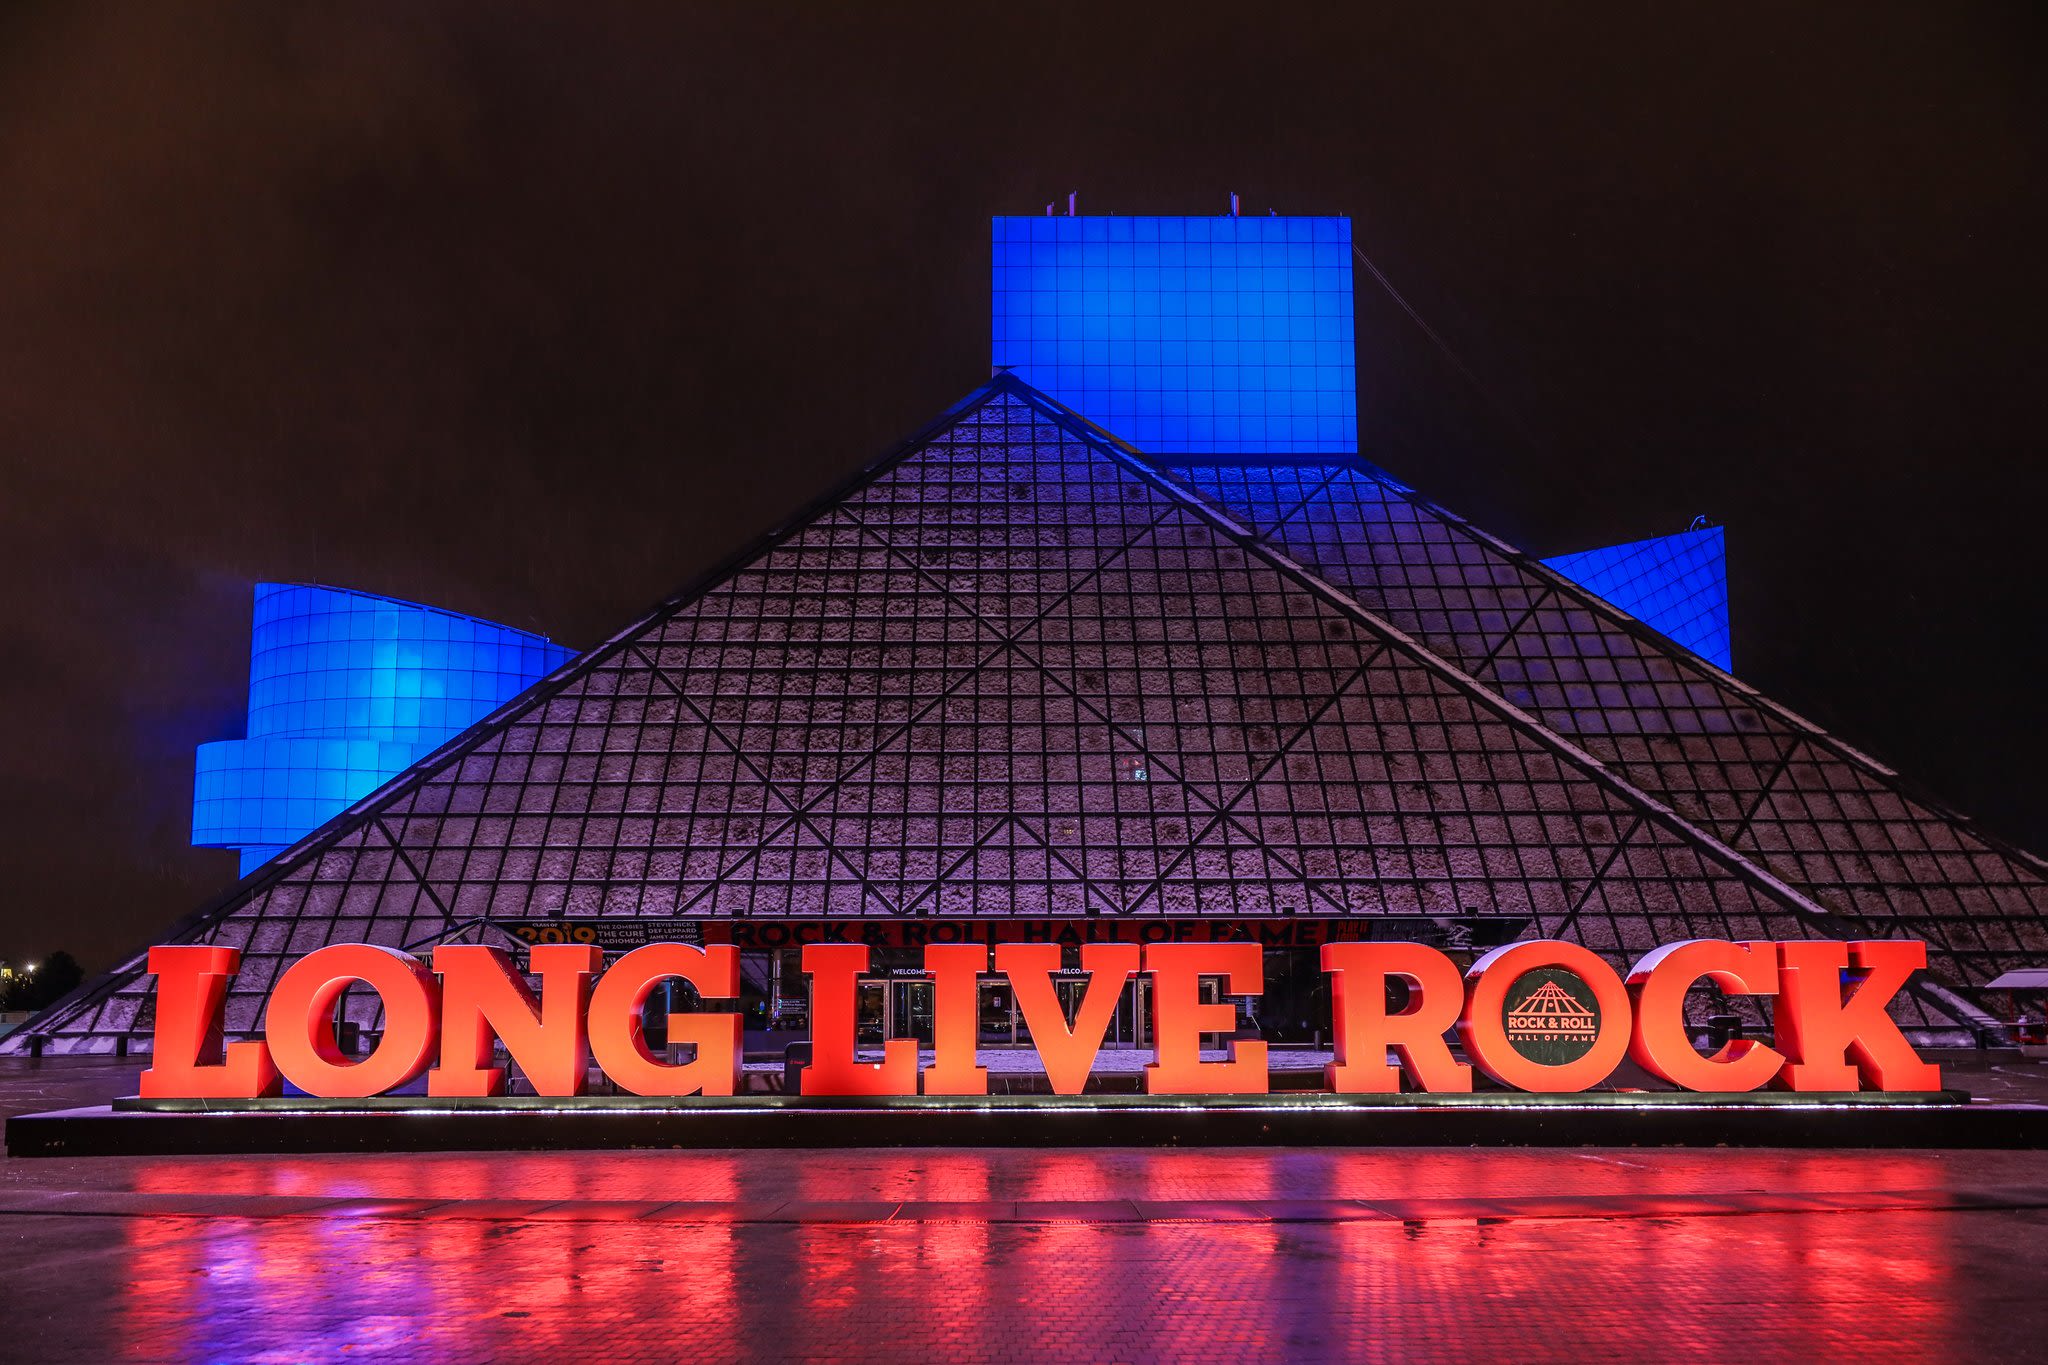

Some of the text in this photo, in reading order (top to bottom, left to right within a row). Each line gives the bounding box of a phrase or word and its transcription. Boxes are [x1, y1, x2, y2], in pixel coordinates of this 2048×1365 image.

[731, 921, 1320, 945] ROCK & ROLL HALL OF FAME
[140, 940, 1942, 1098] LONG LIVE ROCK
[1508, 1017, 1595, 1029] ROCK & ROLL
